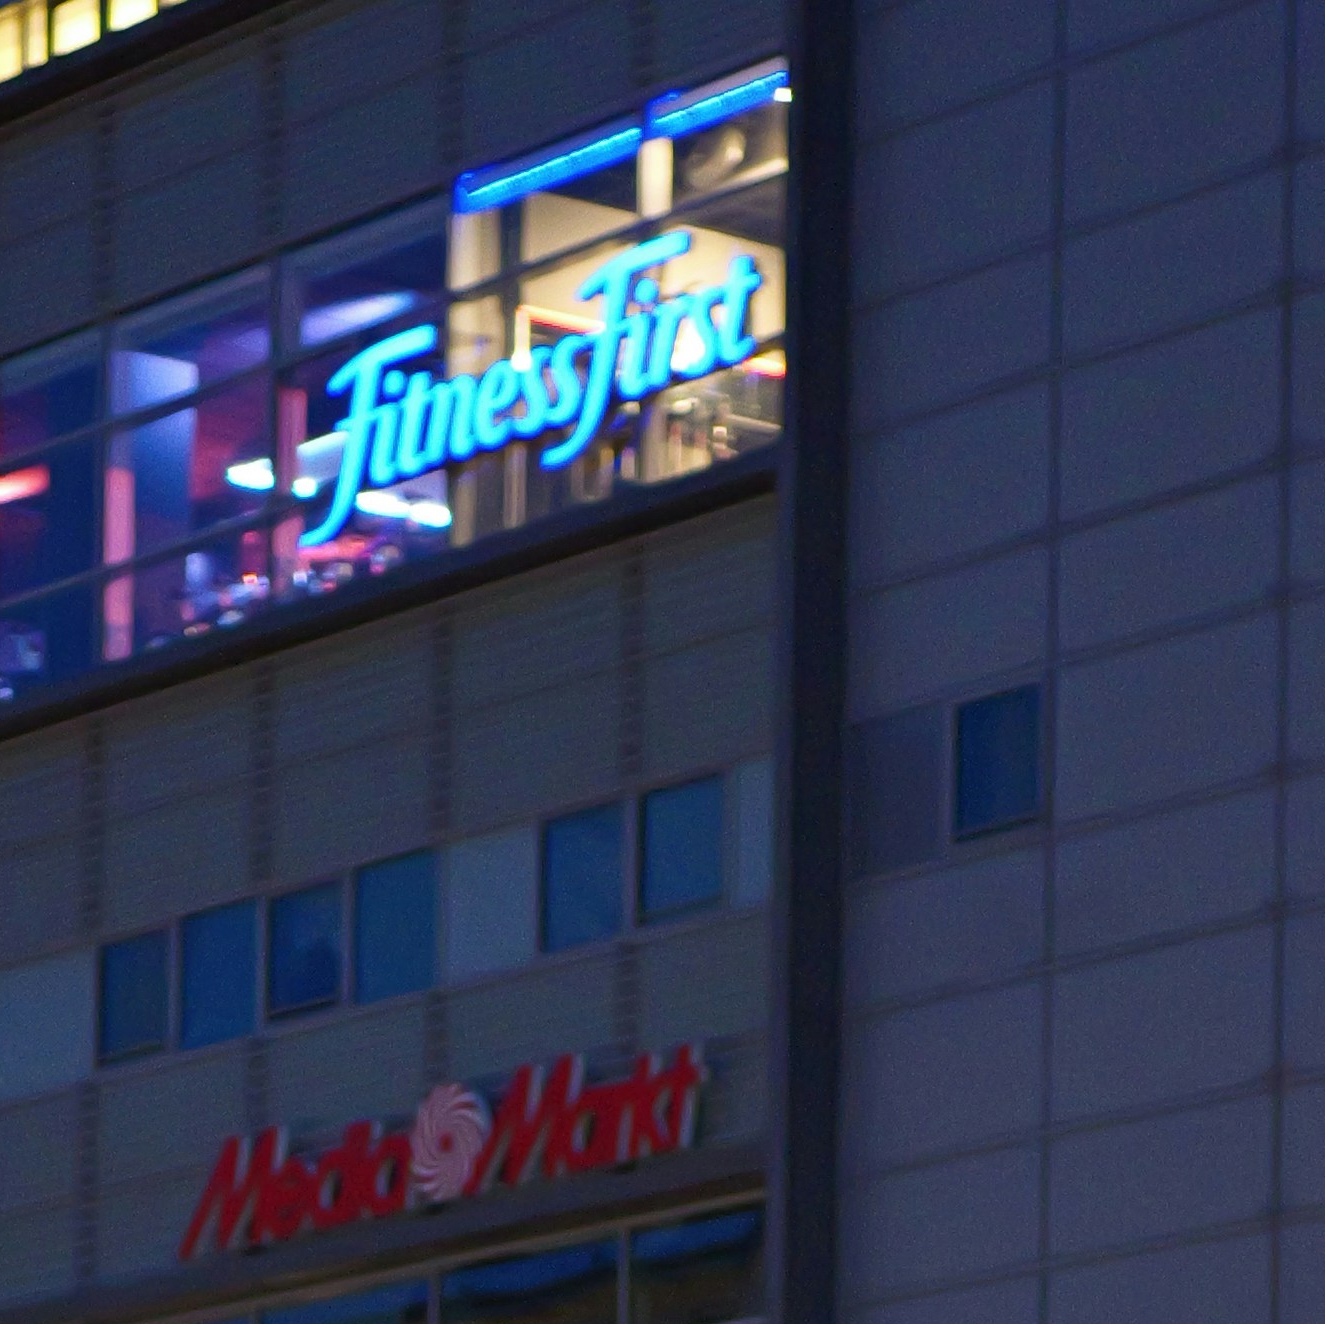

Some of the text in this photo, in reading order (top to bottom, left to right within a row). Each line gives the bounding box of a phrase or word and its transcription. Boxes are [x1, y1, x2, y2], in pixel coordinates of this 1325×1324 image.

[298, 230, 762, 547] Fitness First
[462, 1043, 704, 1196] Markt
